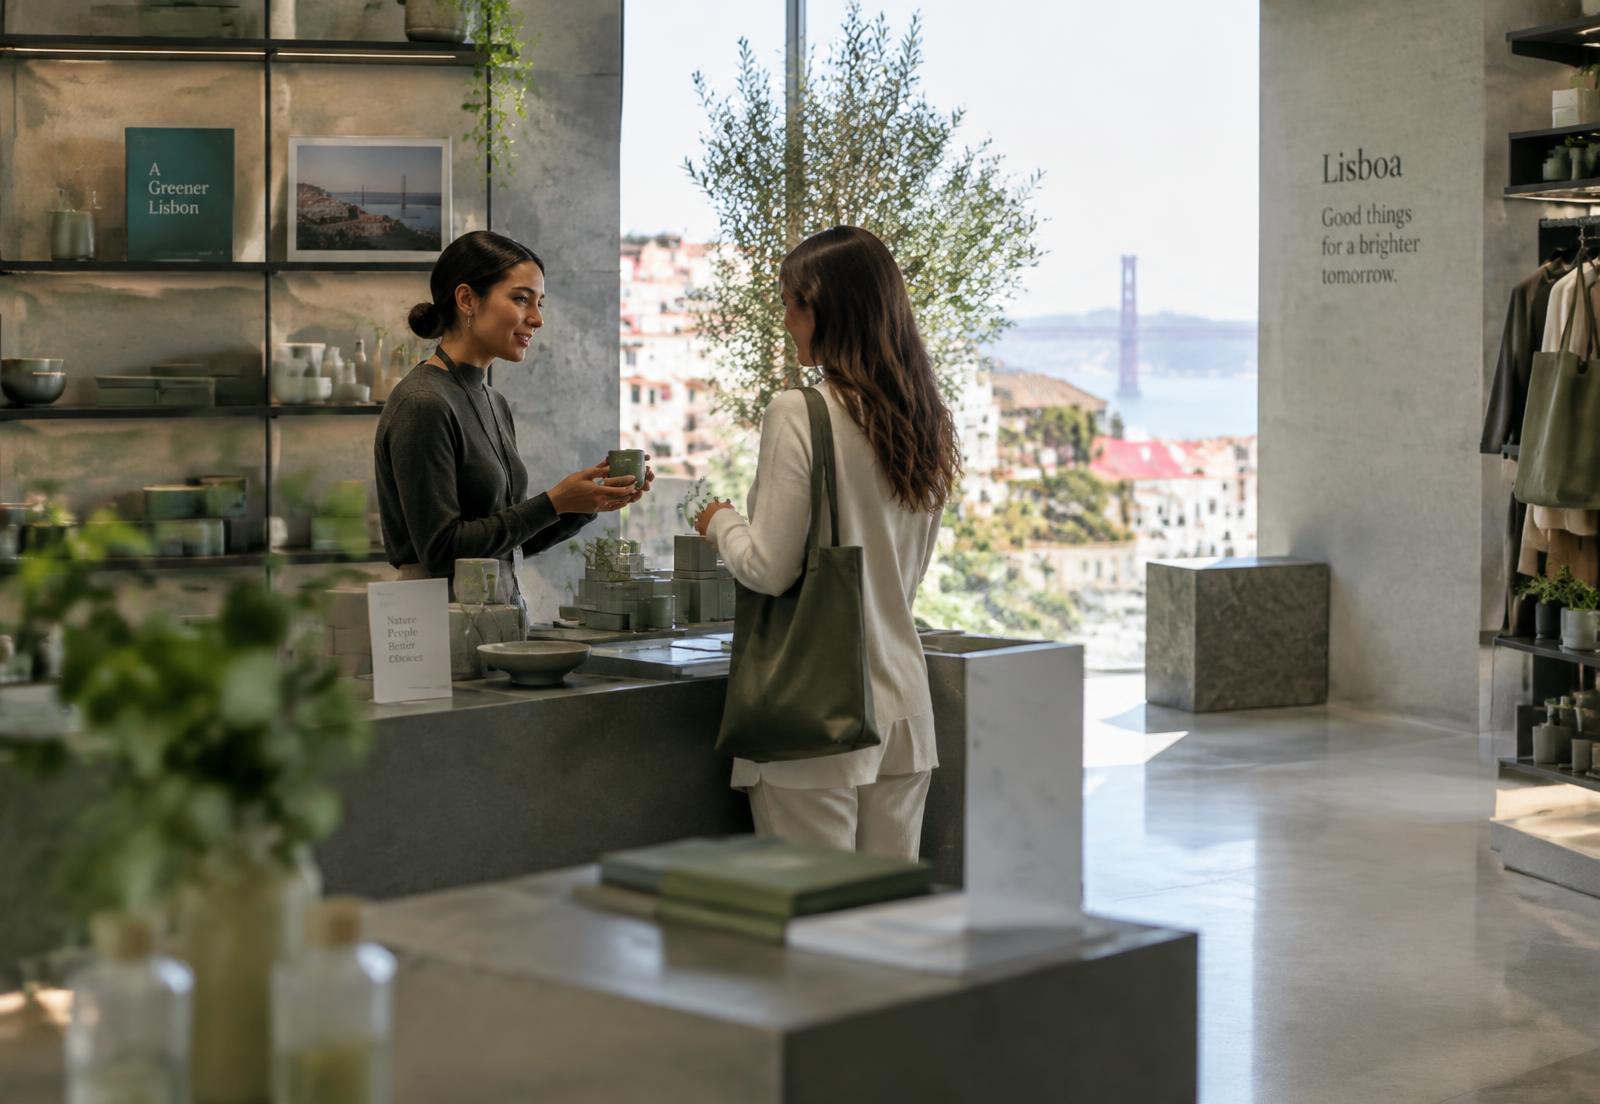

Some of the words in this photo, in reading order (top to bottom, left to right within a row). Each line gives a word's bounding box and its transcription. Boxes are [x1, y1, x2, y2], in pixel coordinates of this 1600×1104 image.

[149, 162, 161, 176] A
[1322, 148, 1403, 184] Lisboa
[148, 180, 209, 195] Greener
[149, 199, 199, 215] Lisbon
[1321, 203, 1362, 227] Good
[1366, 202, 1412, 229] things
[1322, 235, 1343, 256] for
[1346, 240, 1355, 255] a
[1360, 232, 1420, 260] brighter
[1322, 267, 1397, 285] tomorrow.
